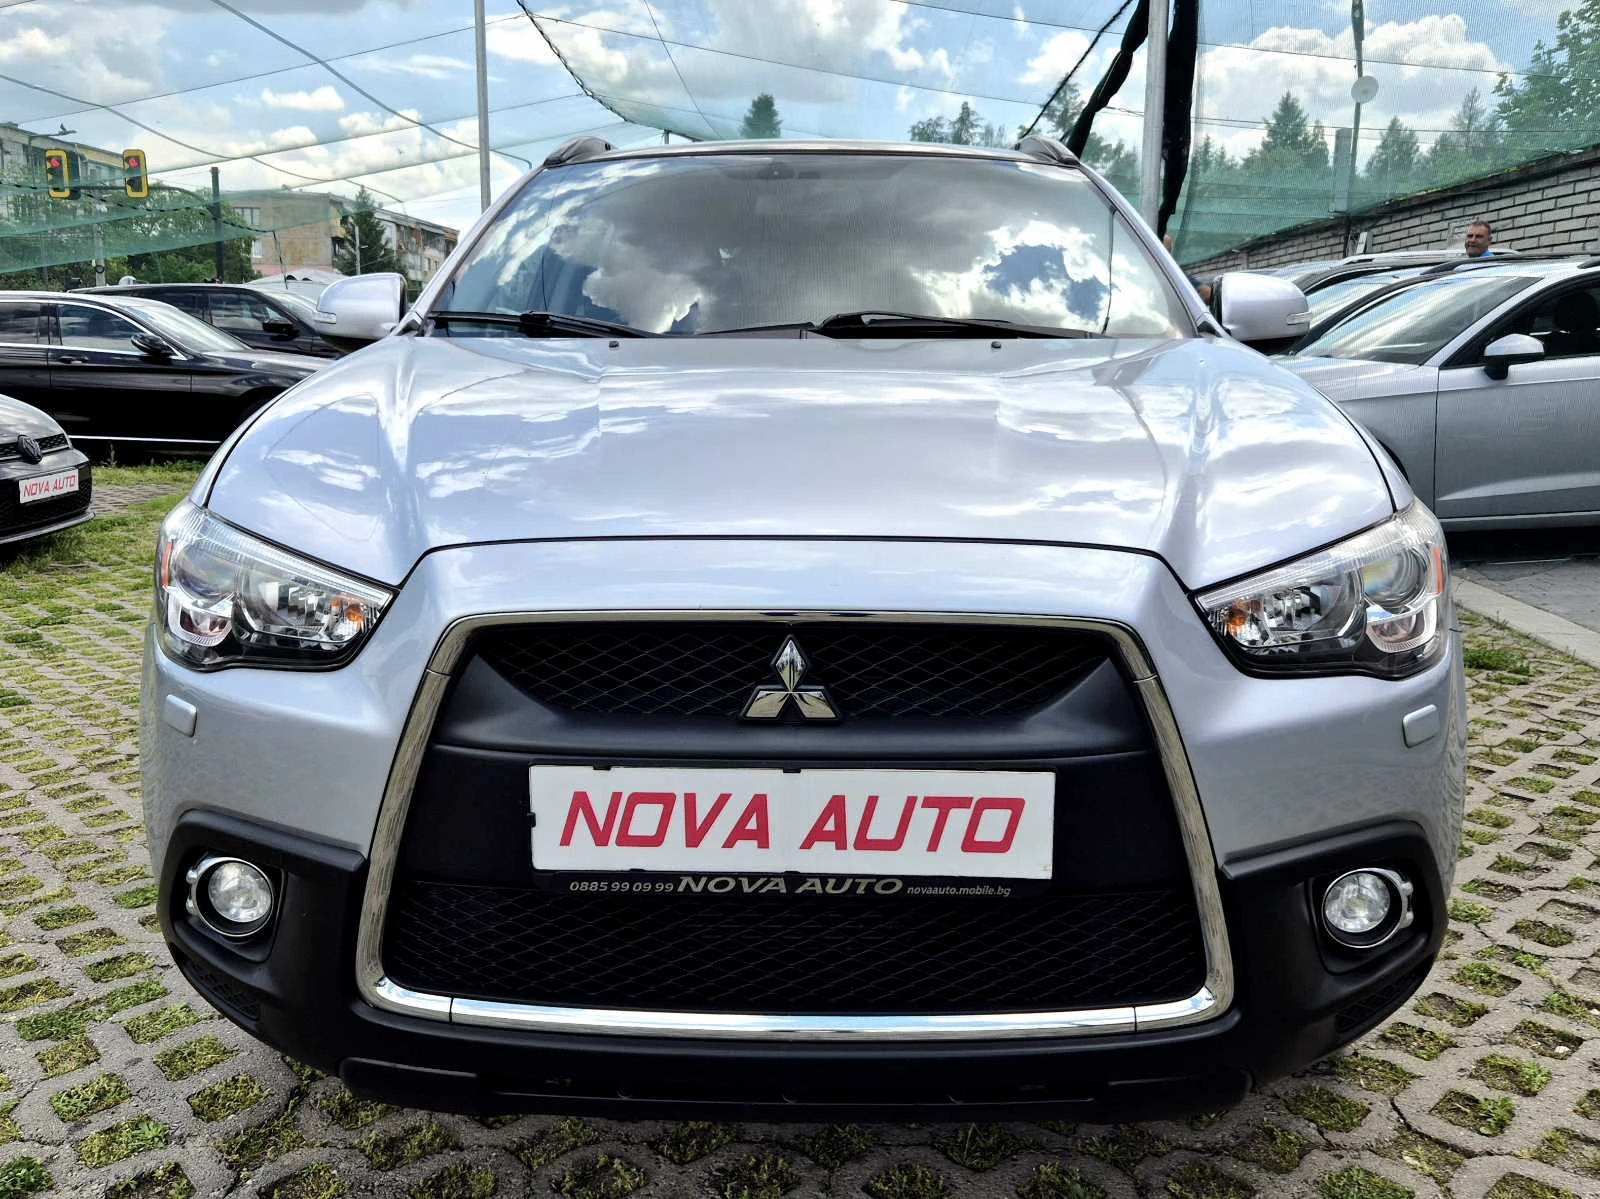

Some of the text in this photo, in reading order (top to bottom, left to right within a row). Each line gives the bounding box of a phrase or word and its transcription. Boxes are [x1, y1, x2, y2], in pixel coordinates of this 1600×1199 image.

[24, 475, 76, 497] NOVA AUTO
[559, 791, 1026, 854] NOVA AUTO
[569, 876, 1011, 897] 0885 99 09 99 NOVA AUTO novaauto.mobile.bg
